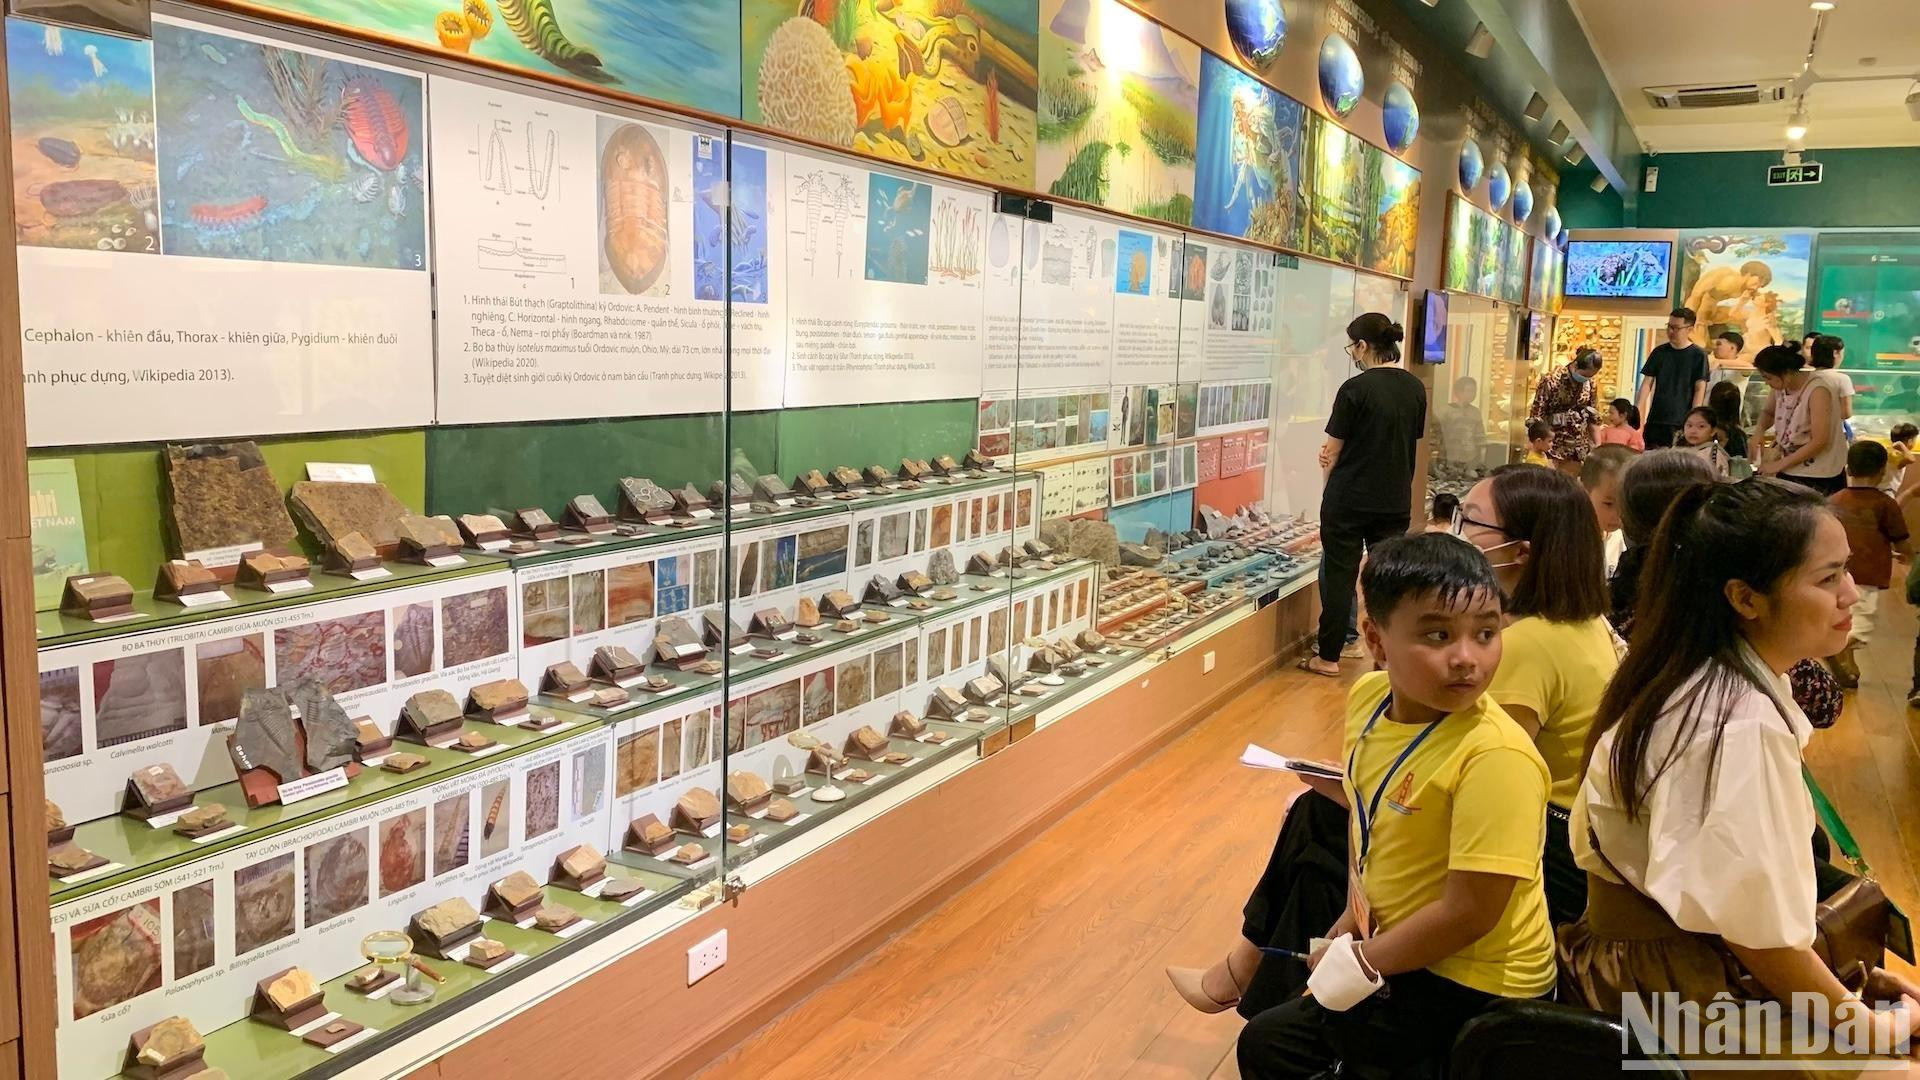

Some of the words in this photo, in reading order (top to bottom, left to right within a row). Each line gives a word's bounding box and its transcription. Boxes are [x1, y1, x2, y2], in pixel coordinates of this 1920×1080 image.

[144, 237, 155, 251] 2
[414, 254, 422, 267] 3
[570, 277, 575, 289] 1
[664, 283, 671, 296] 2
[517, 312, 555, 324] Horizontal
[24, 328, 94, 344] Cephalon
[106, 329, 143, 342] khiên
[146, 329, 174, 344] đầu,
[176, 330, 218, 343] Thorax
[228, 331, 260, 344] khiên
[262, 332, 289, 346] giữa,
[291, 332, 340, 346] Pygidium
[347, 333, 375, 344] khiên
[376, 333, 398, 345] đuôi
[471, 326, 495, 337] Theca
[463, 342, 471, 352] 2.
[485, 342, 496, 352] ba
[545, 343, 577, 353] maximus
[592, 343, 619, 354] Ordovic
[472, 357, 514, 370] (Wikipedia
[51, 370, 87, 386] phục
[90, 369, 130, 385] dựng,
[132, 369, 195, 384] Wikipedia
[199, 369, 234, 382] 2013).
[463, 373, 471, 384] 3.
[513, 372, 530, 383] sinh
[573, 371, 600, 382] Ordovic
[134, 642, 145, 650] BA
[69, 907, 82, 920] VÀ
[120, 886, 153, 902] CAMBRI
[174, 867, 207, 885] (541-521
[100, 1010, 116, 1024] Sứa
